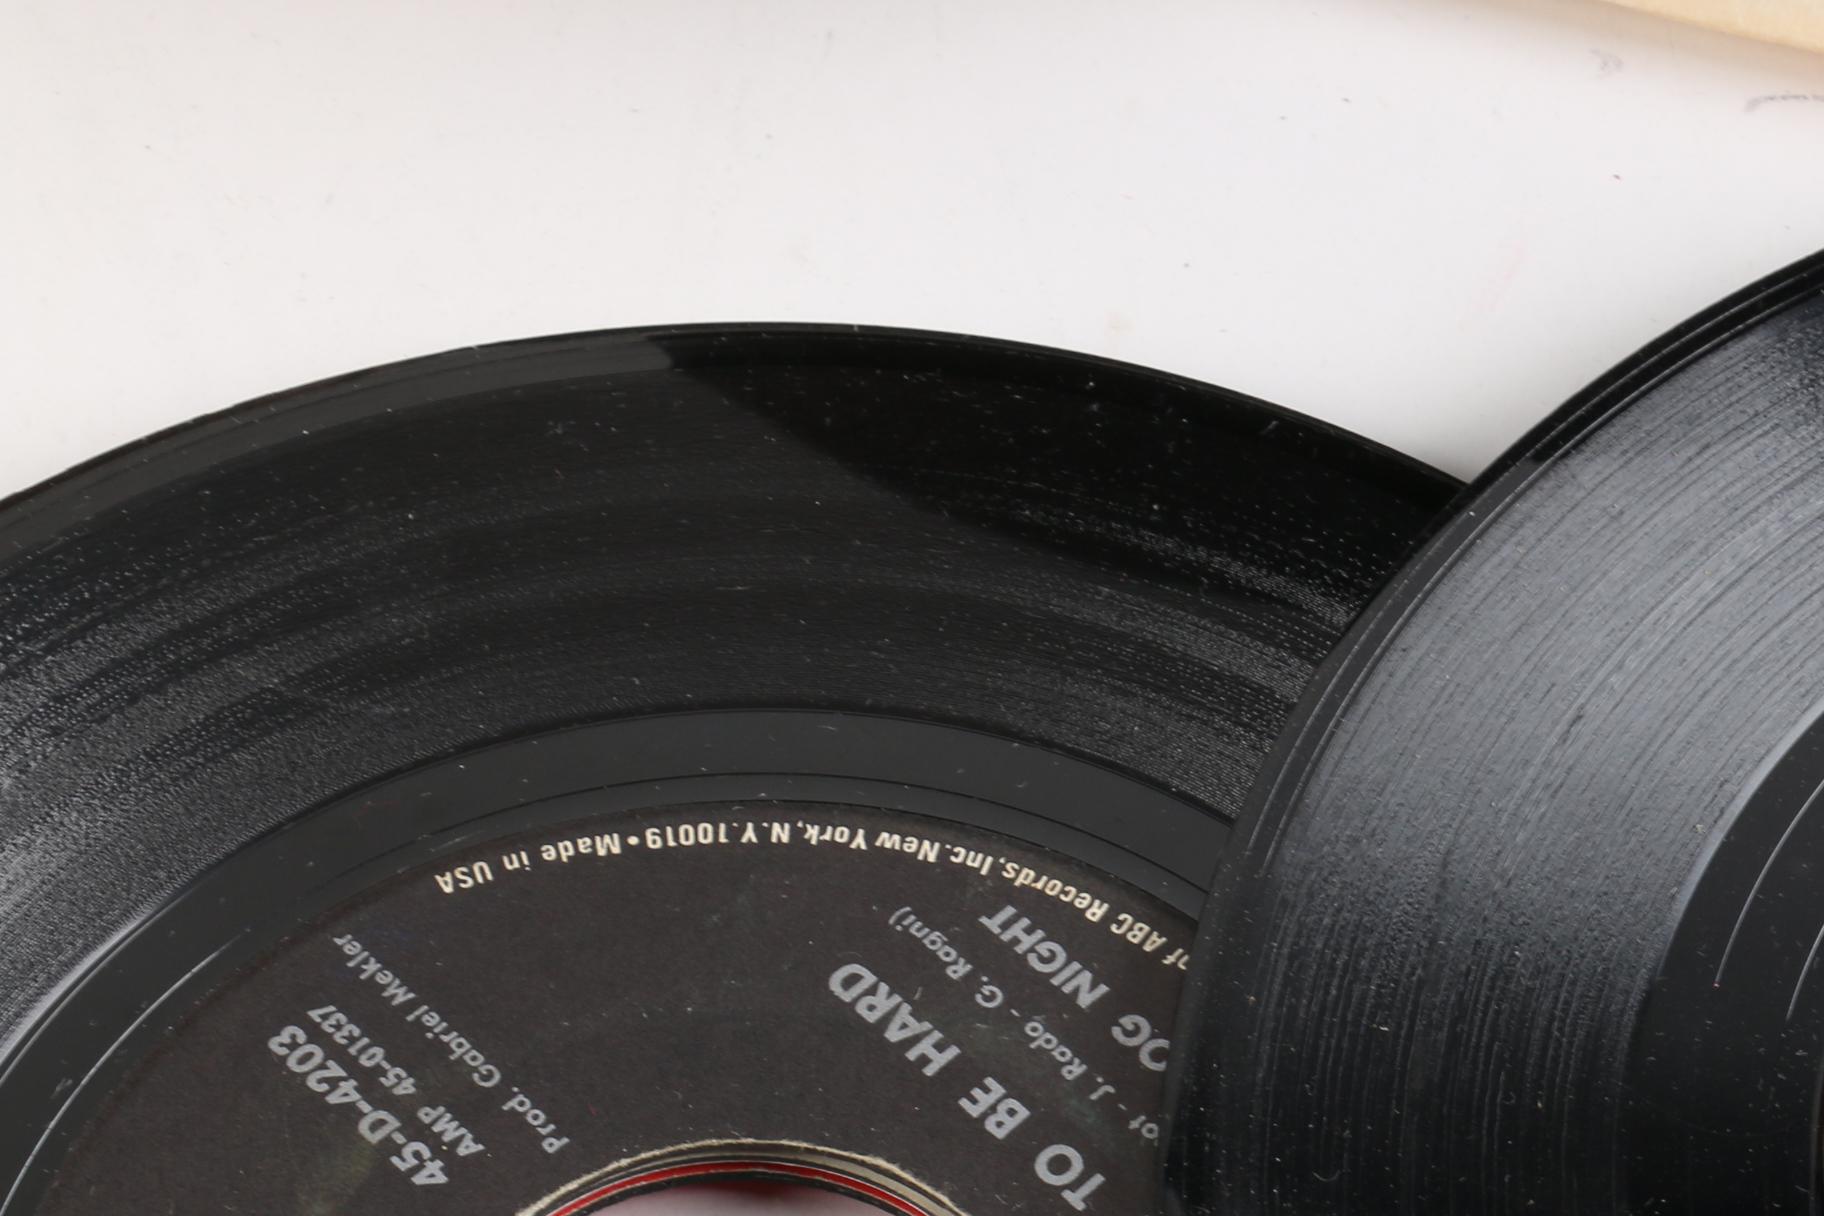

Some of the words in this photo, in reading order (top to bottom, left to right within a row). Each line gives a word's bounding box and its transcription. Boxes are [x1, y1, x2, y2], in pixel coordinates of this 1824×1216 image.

[434, 860, 494, 894] USA
[500, 849, 530, 872] in
[888, 906, 973, 981] Ragni)
[977, 904, 1110, 1009] NIGHT
[1110, 912, 1168, 953] ABC
[331, 933, 416, 1006] Mekler
[974, 975, 1004, 1009] G.
[306, 1004, 418, 1099] 45-01337
[405, 1003, 502, 1089] Gabriel
[828, 962, 962, 1078] HARD
[1023, 1021, 1088, 1081] Rado
[267, 1024, 449, 1187] 45-D-4203
[415, 1105, 485, 1157] AMP
[501, 1086, 571, 1155] Prod.
[958, 1077, 1031, 1140] BE
[1034, 1143, 1106, 1212] TO
